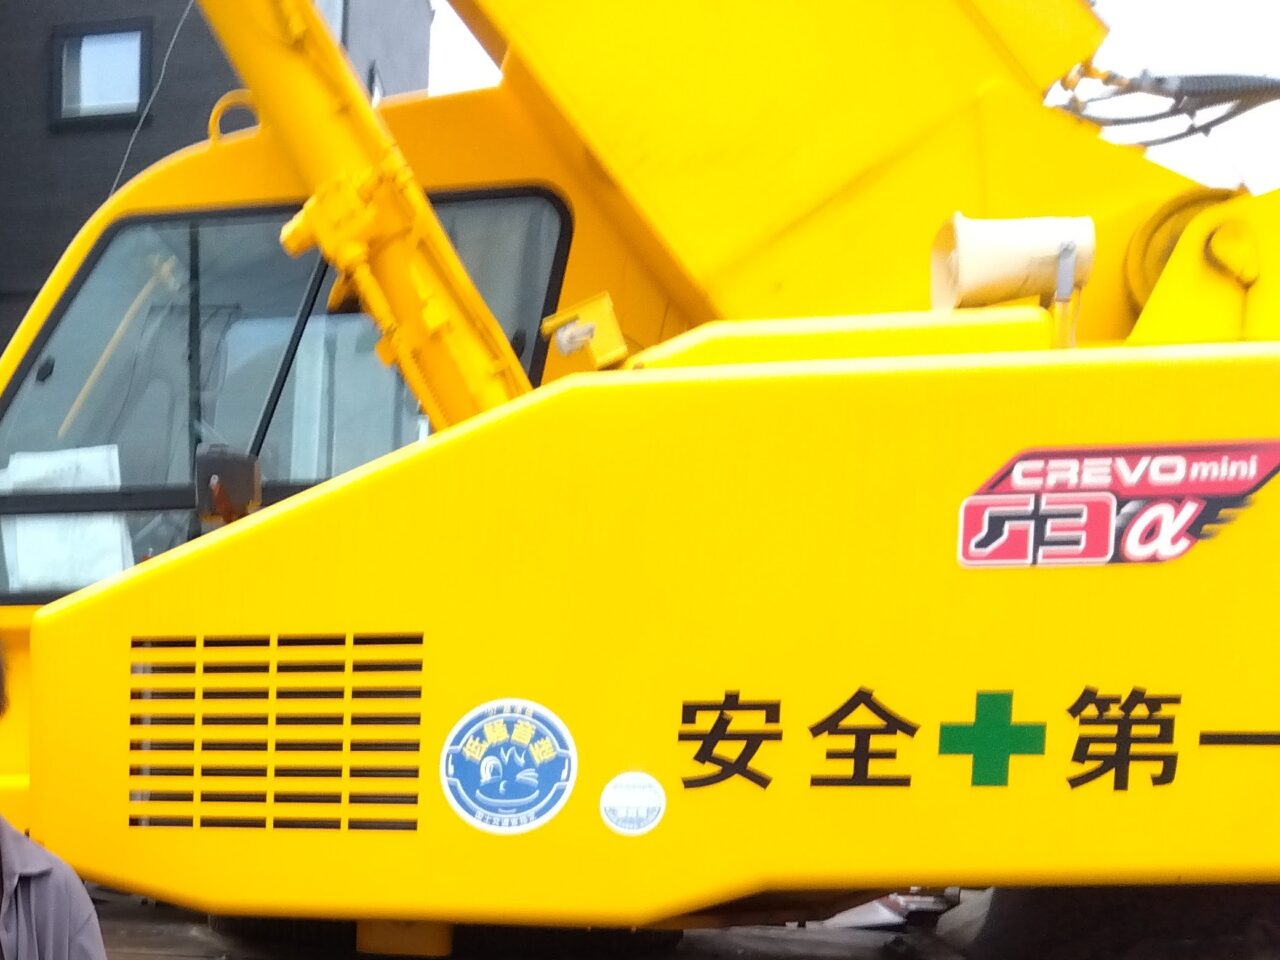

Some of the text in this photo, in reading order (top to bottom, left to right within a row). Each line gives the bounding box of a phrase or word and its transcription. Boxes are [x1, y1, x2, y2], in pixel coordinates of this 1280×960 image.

[1010, 454, 1258, 488] CREVO mini
[677, 686, 1280, 792] 安全 第一
